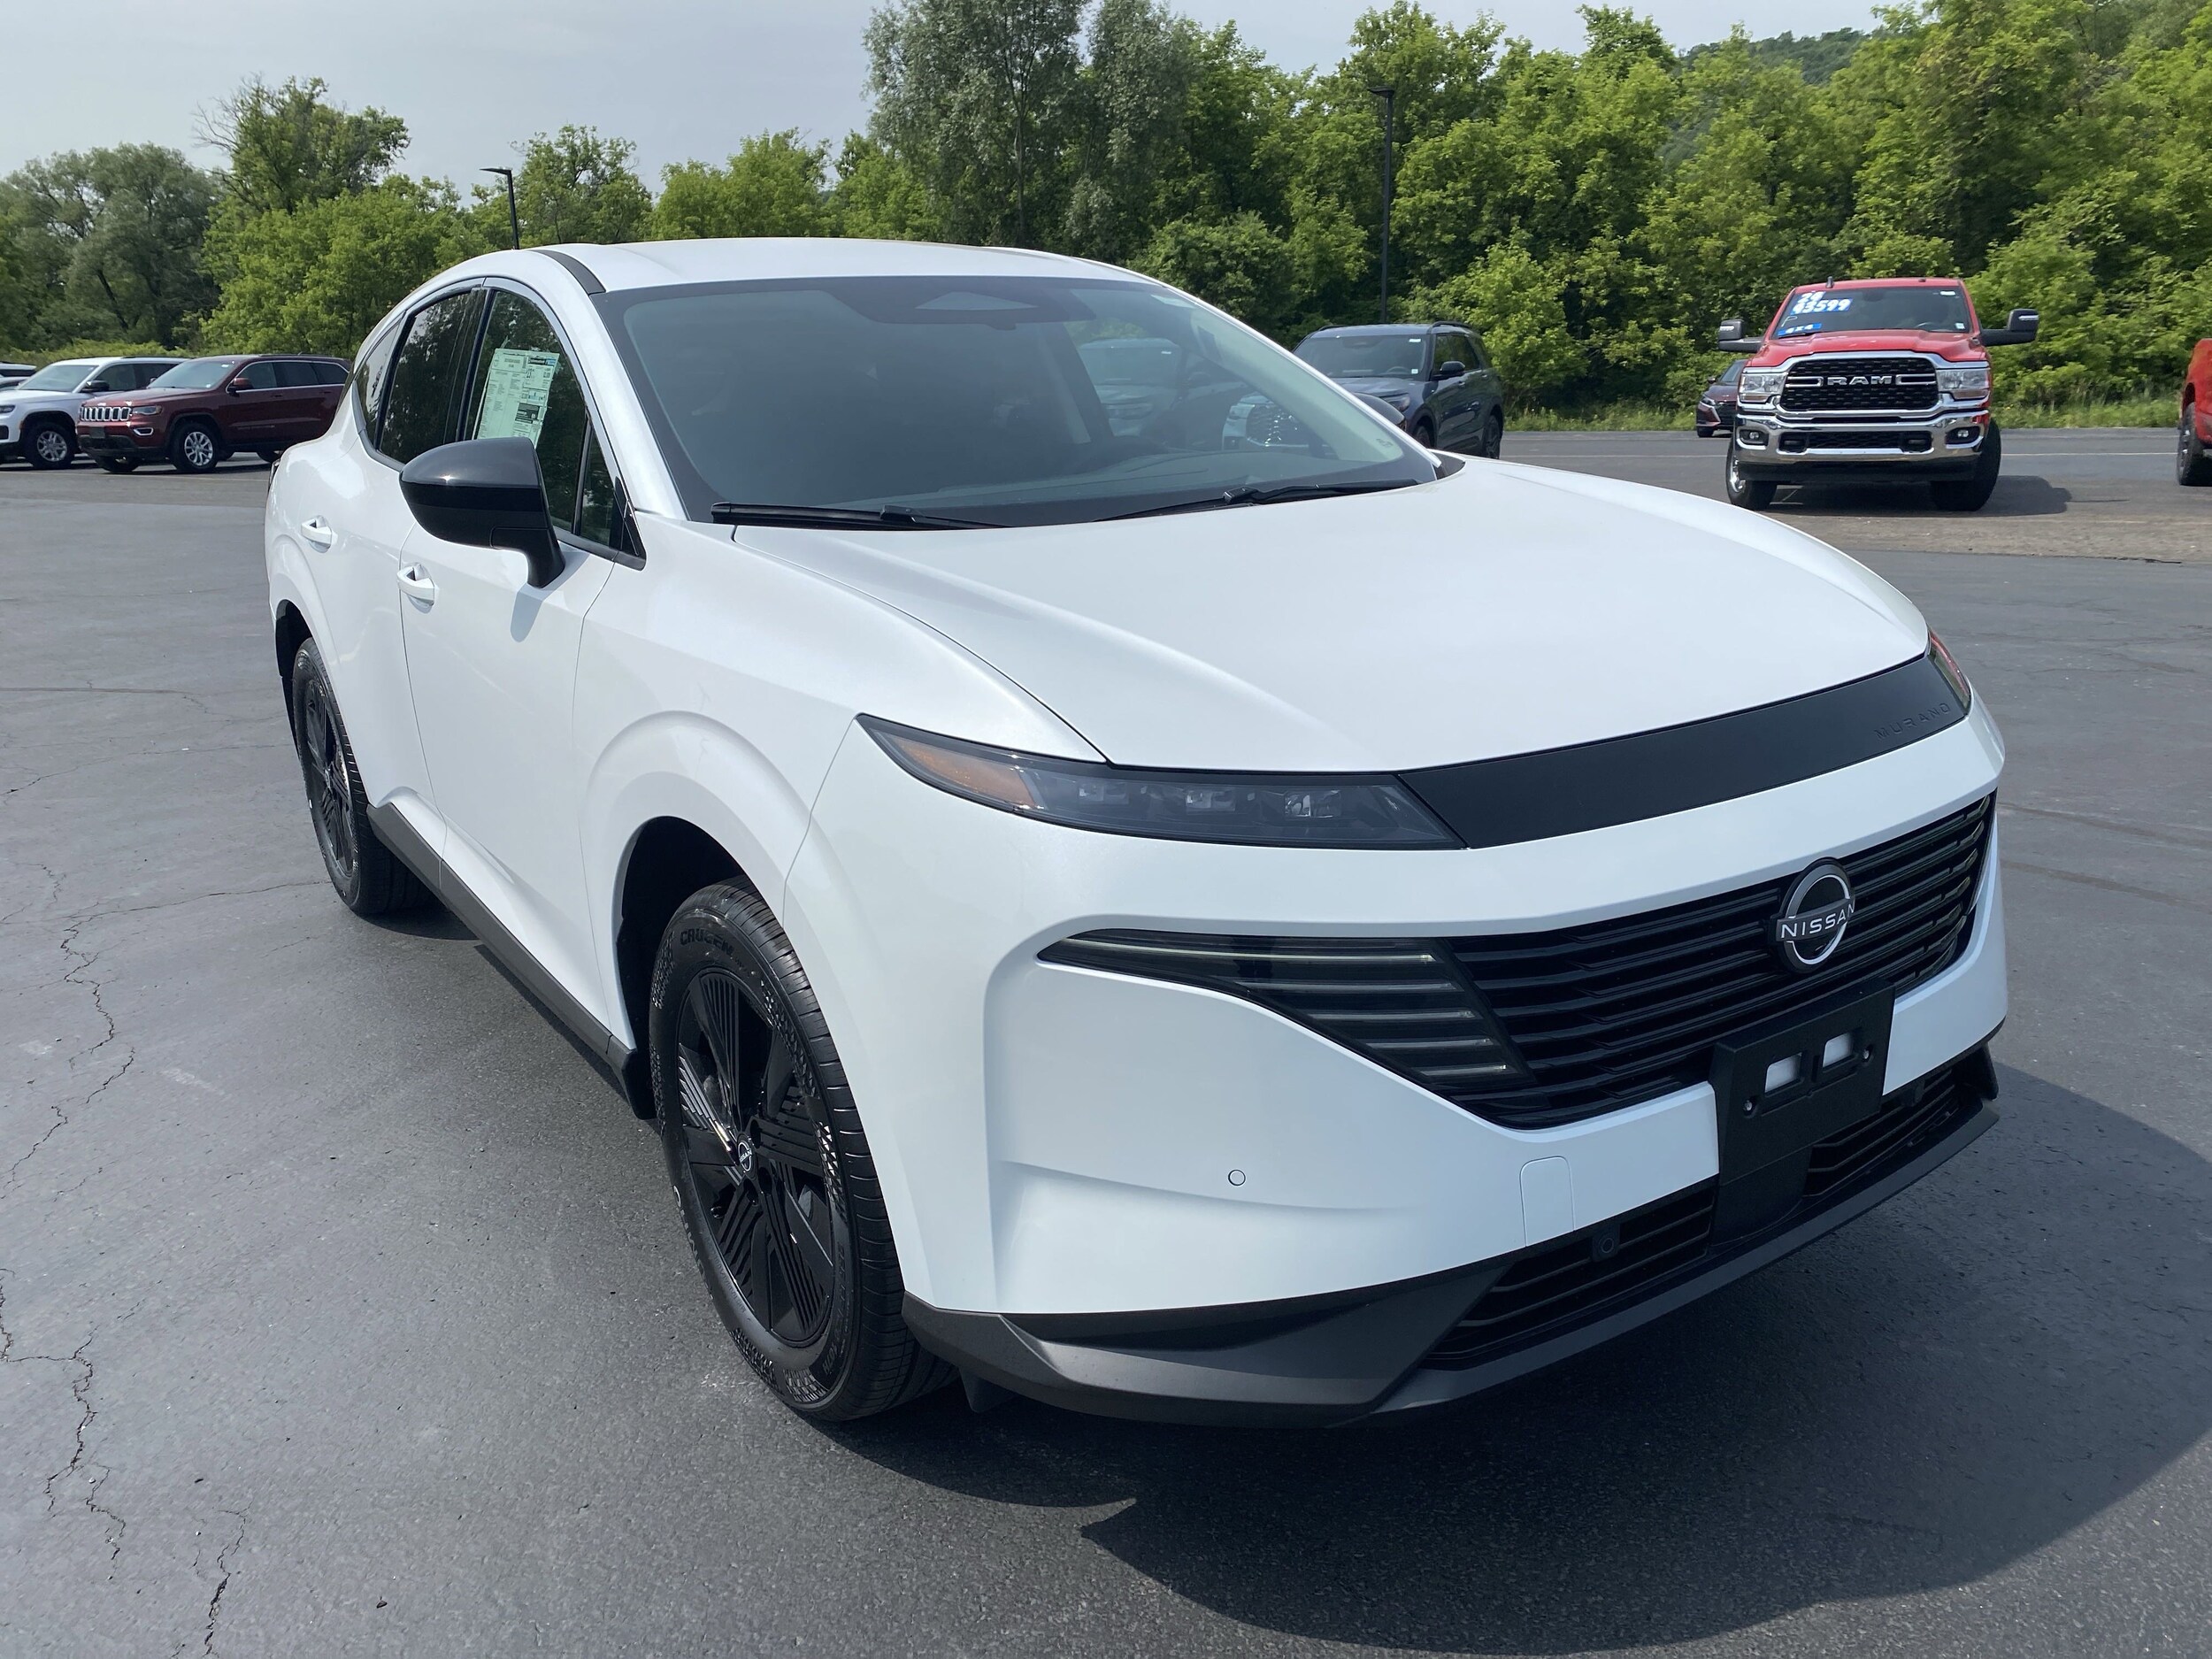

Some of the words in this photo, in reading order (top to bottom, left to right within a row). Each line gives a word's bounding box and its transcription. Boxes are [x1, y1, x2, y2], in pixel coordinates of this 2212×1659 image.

[1827, 375, 1893, 386] RAM
[1873, 703, 1951, 741] MURANO
[1780, 902, 1855, 939] NISSAN
